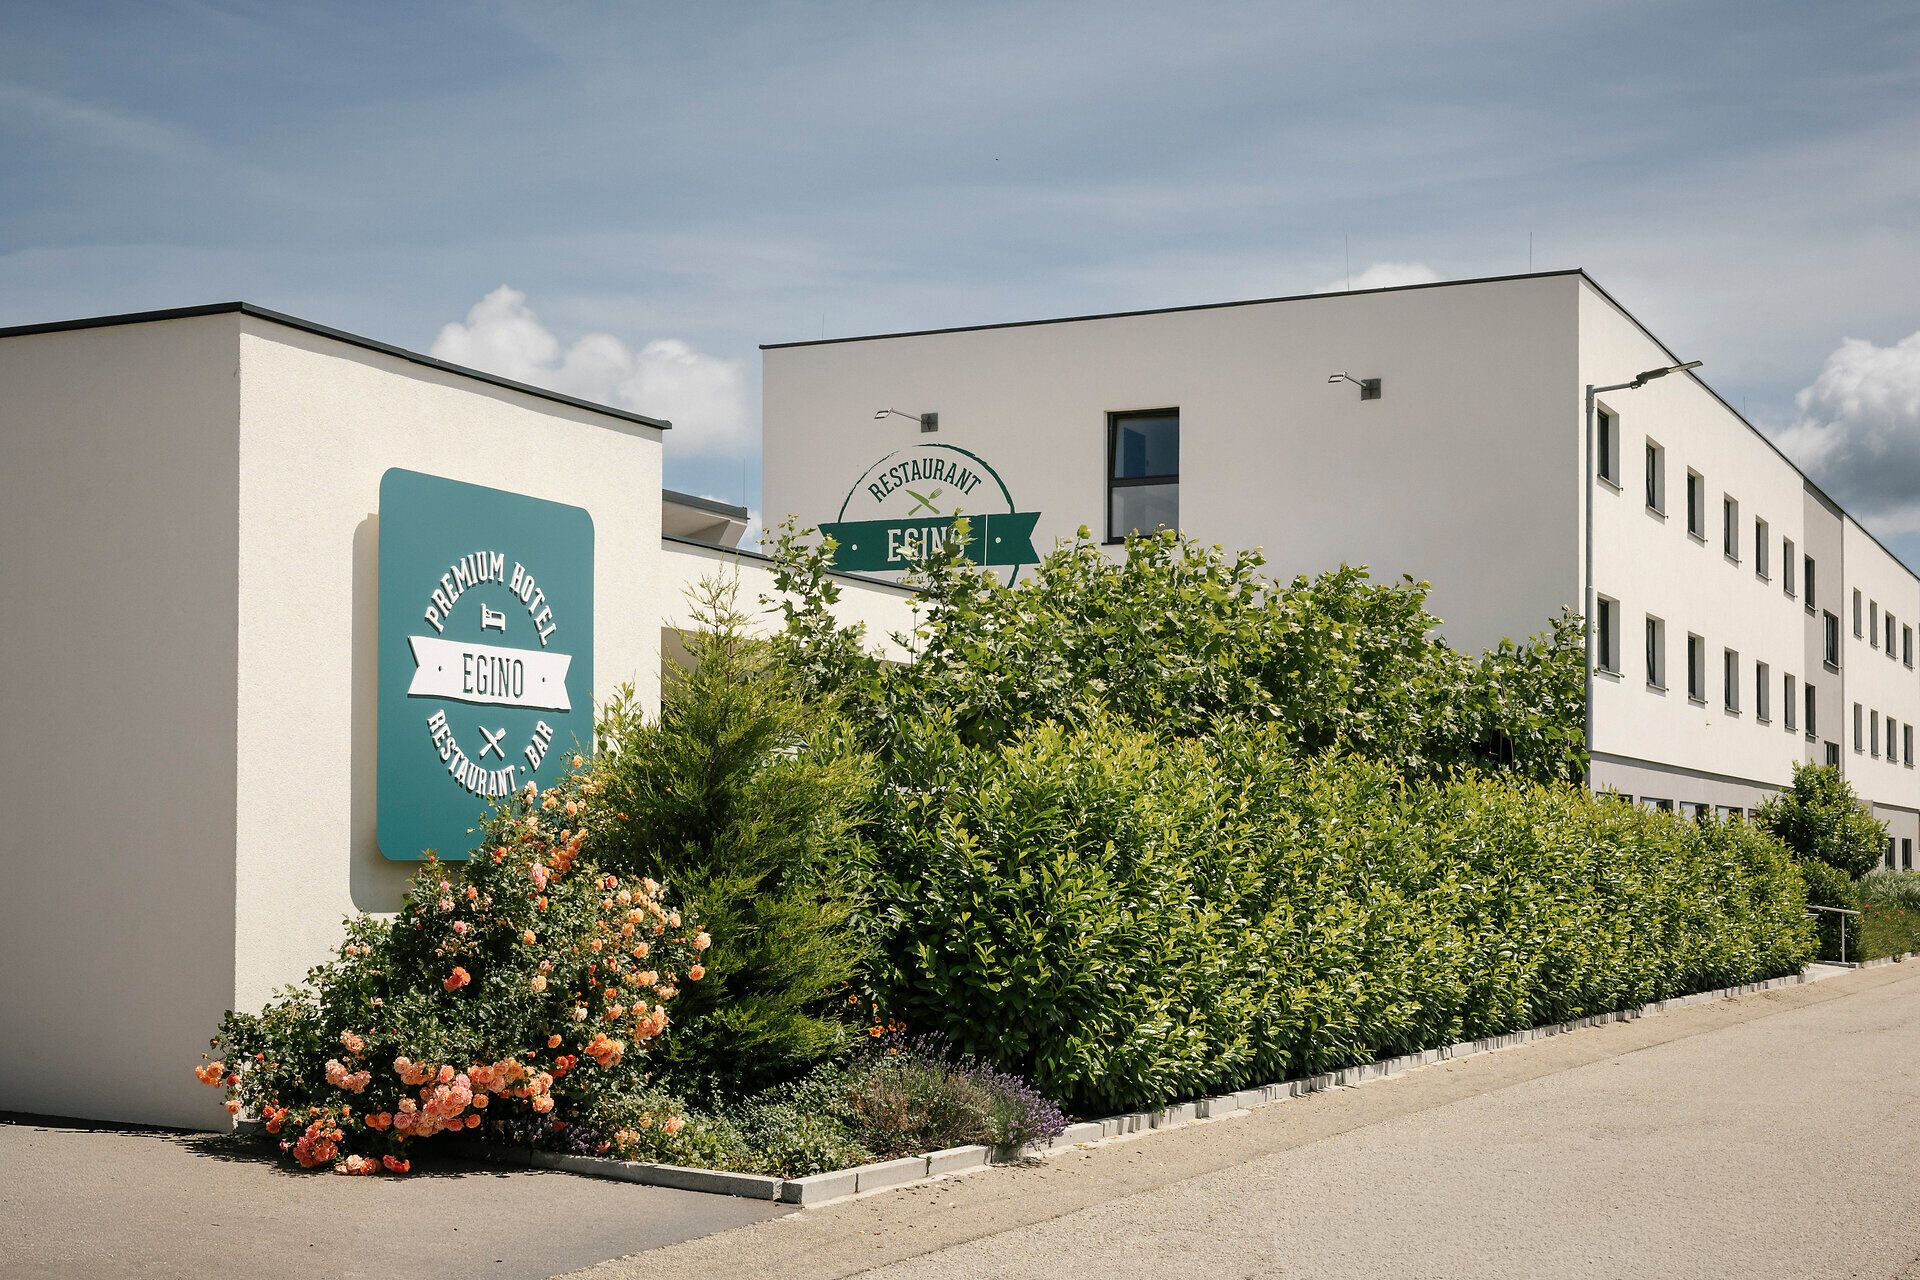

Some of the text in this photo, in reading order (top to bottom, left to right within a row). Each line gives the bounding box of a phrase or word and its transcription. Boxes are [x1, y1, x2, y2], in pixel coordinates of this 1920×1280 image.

[867, 458, 982, 503] RESTAURANT
[424, 551, 557, 646] PREMIUM HOTEL
[463, 653, 523, 698] EGINO
[427, 709, 554, 796] RESTAURANT BAR
